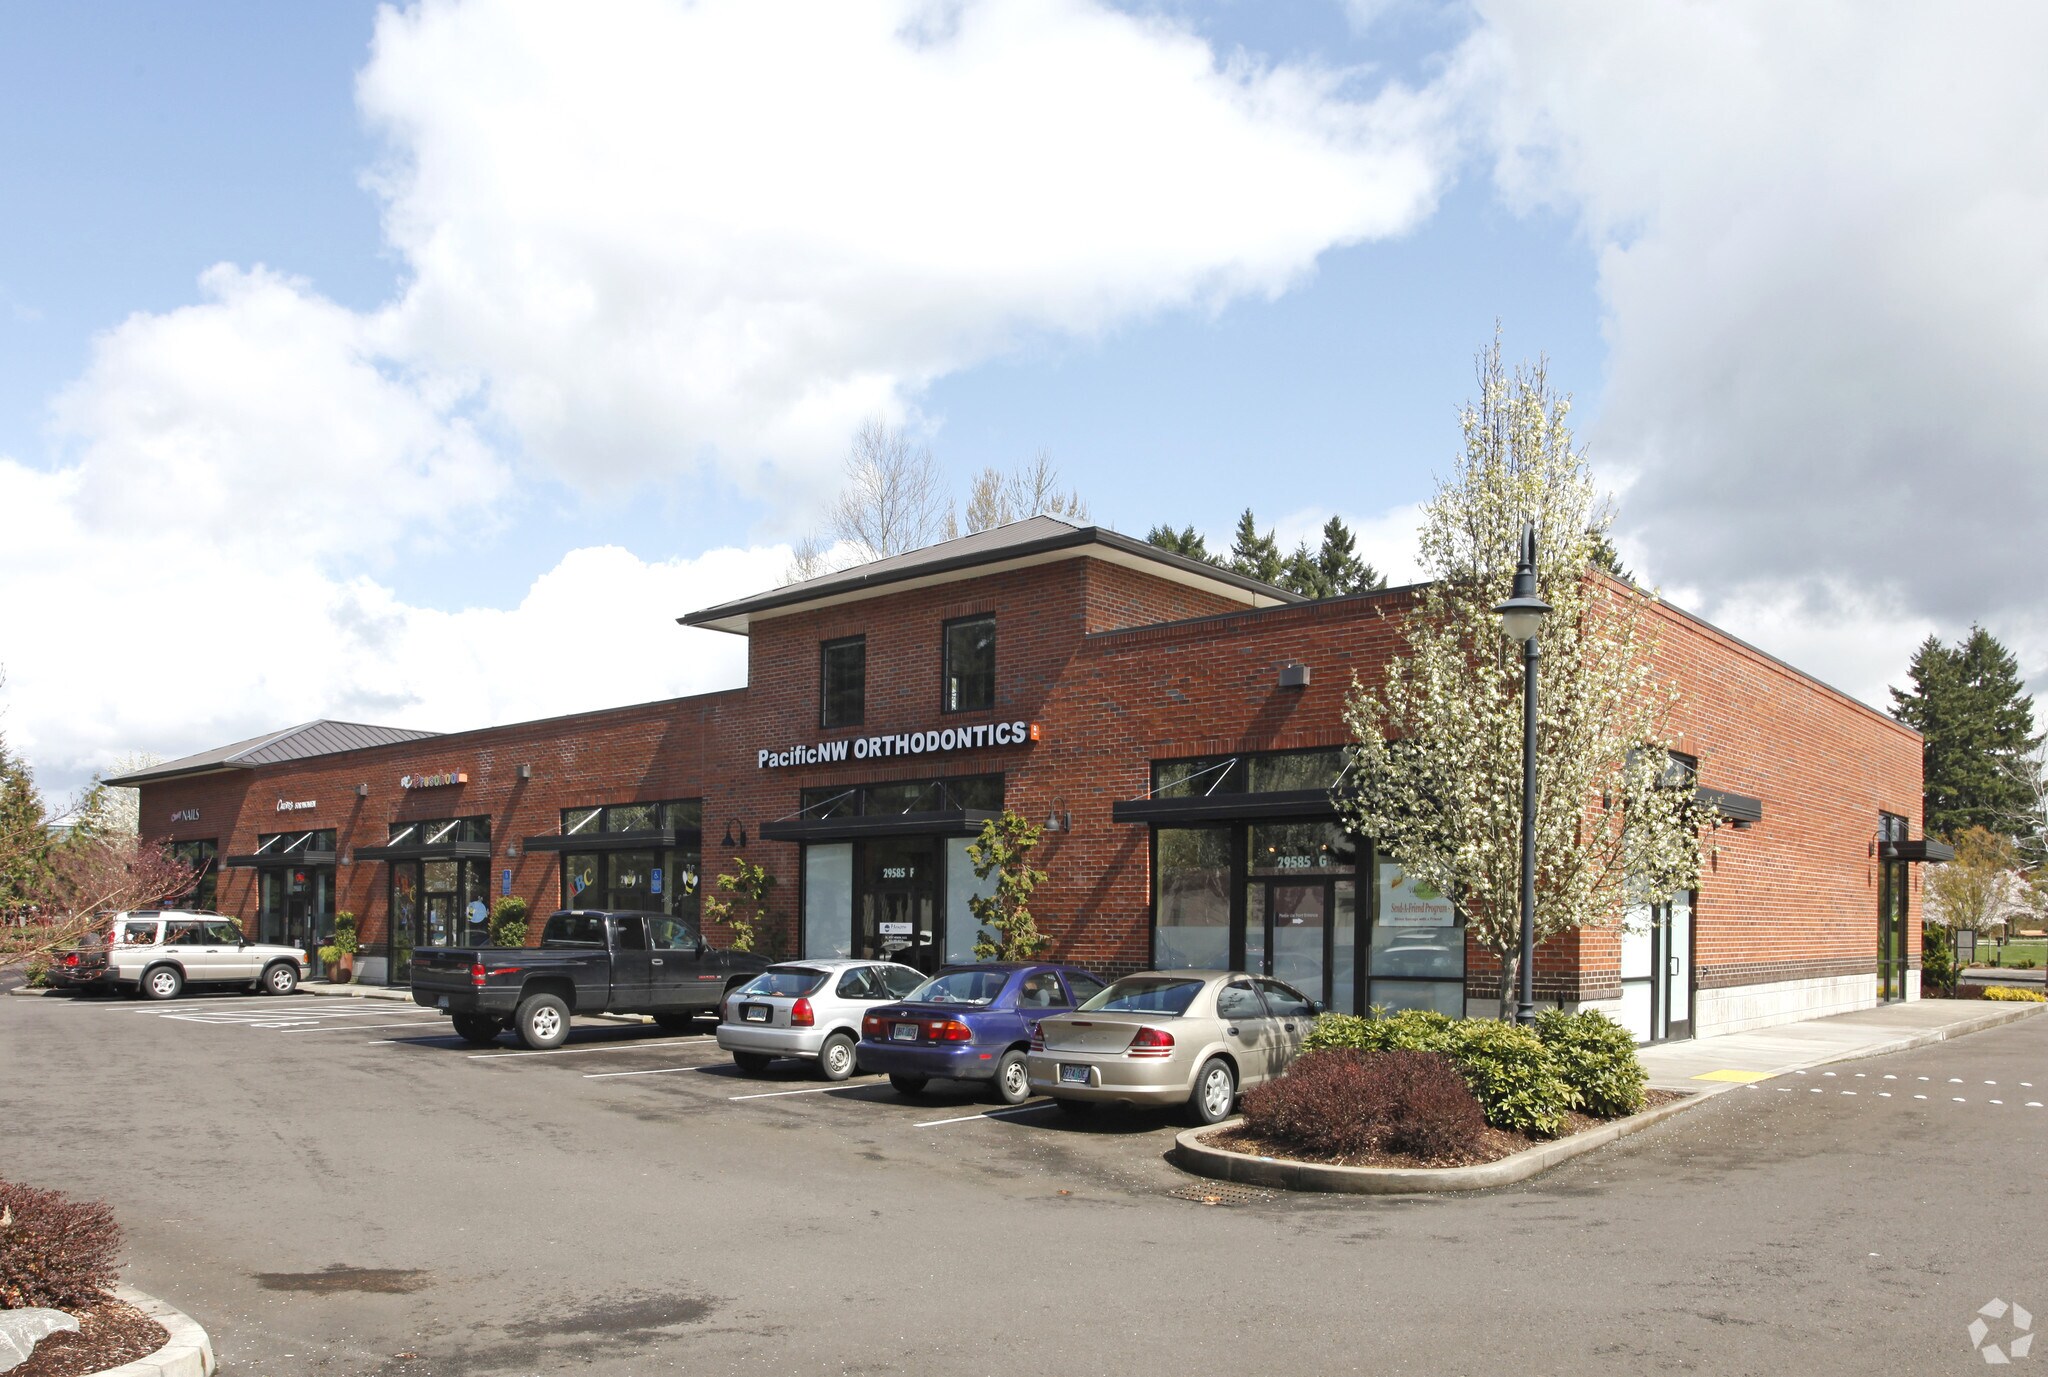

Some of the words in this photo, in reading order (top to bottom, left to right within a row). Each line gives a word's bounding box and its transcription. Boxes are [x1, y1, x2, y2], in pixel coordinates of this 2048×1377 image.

[758, 740, 849, 769] PacificNW
[853, 721, 1026, 759] ORTHODONTICS
[413, 767, 460, 789] Preschool
[182, 808, 200, 822] NAILS
[1277, 855, 1312, 869] 29585
[1318, 855, 1328, 868] G
[883, 867, 906, 879] 29585
[909, 867, 915, 878] F
